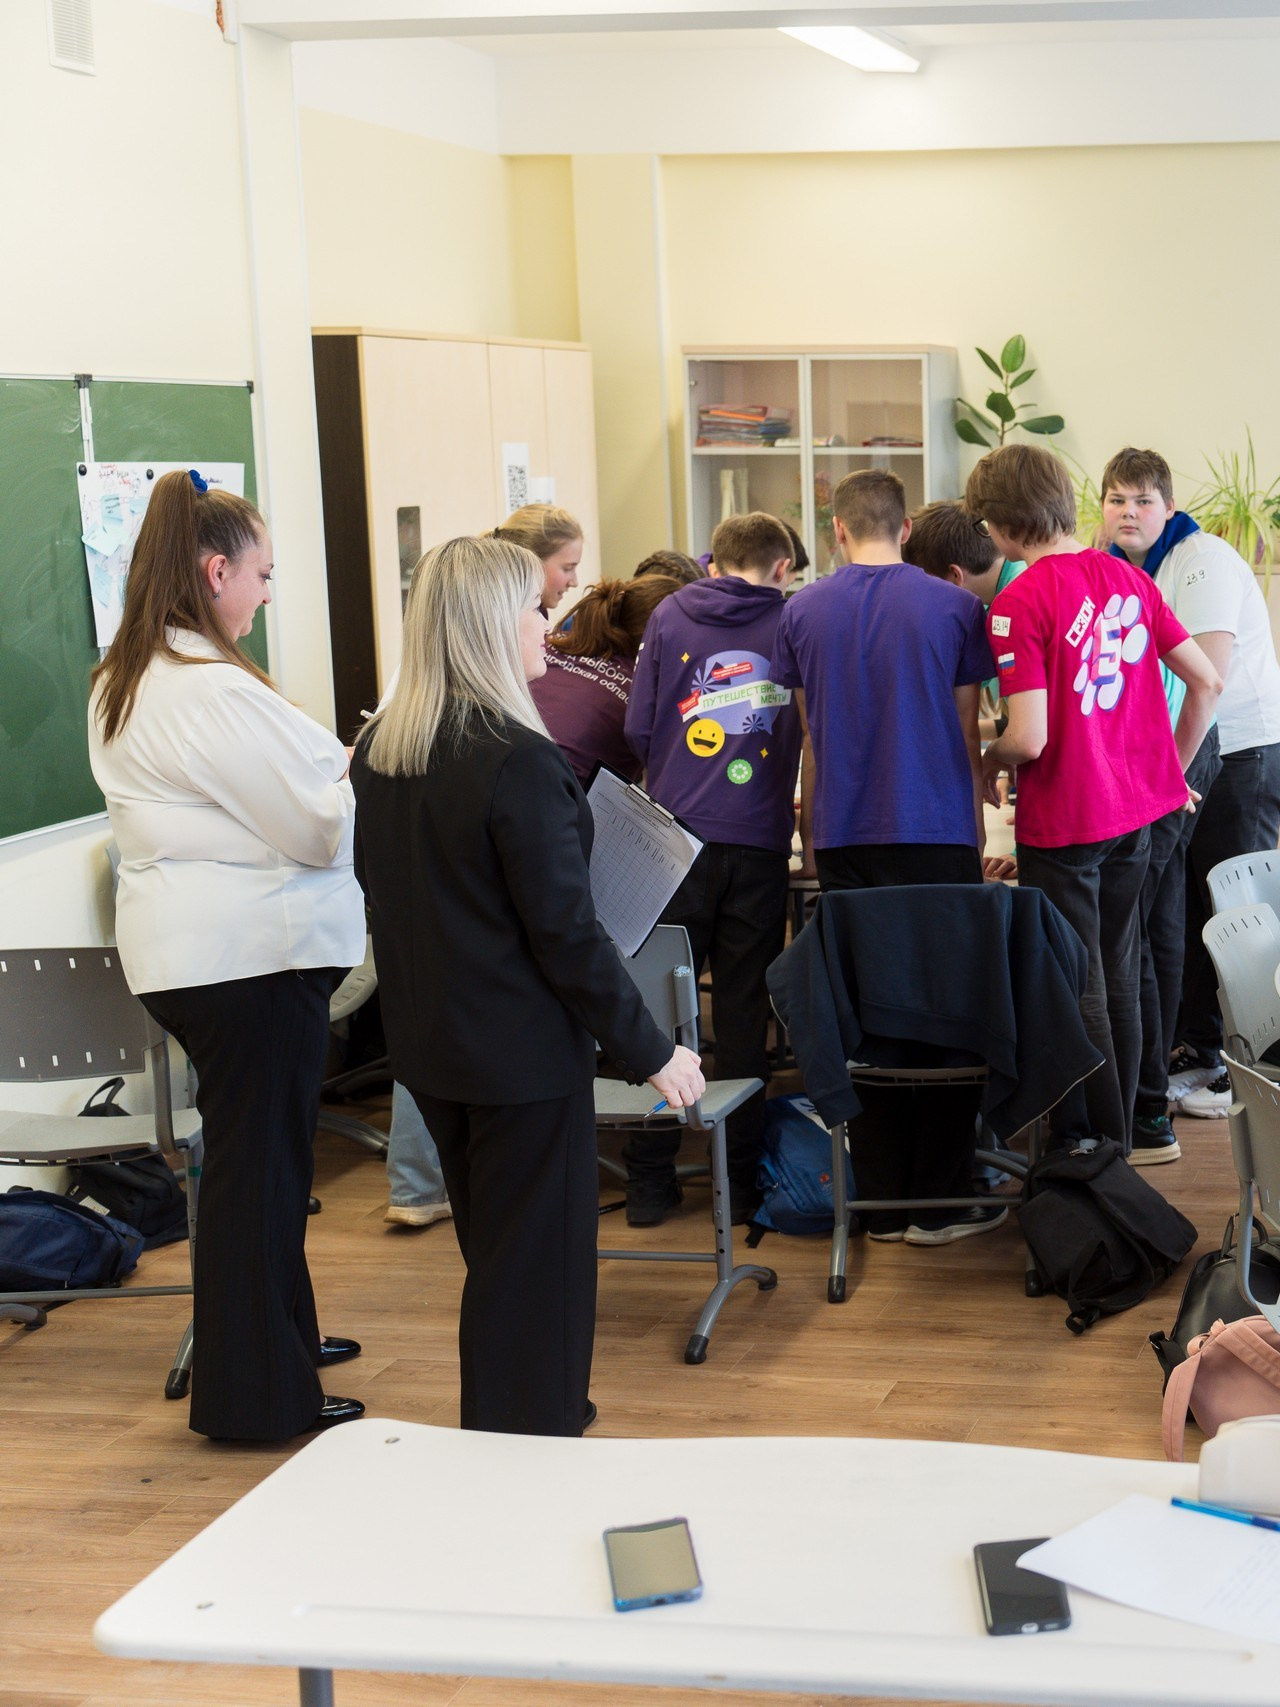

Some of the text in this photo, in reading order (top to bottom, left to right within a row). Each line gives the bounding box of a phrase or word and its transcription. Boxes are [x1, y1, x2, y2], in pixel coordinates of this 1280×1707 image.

[1065, 595, 1096, 648] СЕЗОН
[1094, 616, 1122, 682] 5
[702, 683, 777, 709] ПУТЕШЕСТВИЕ
